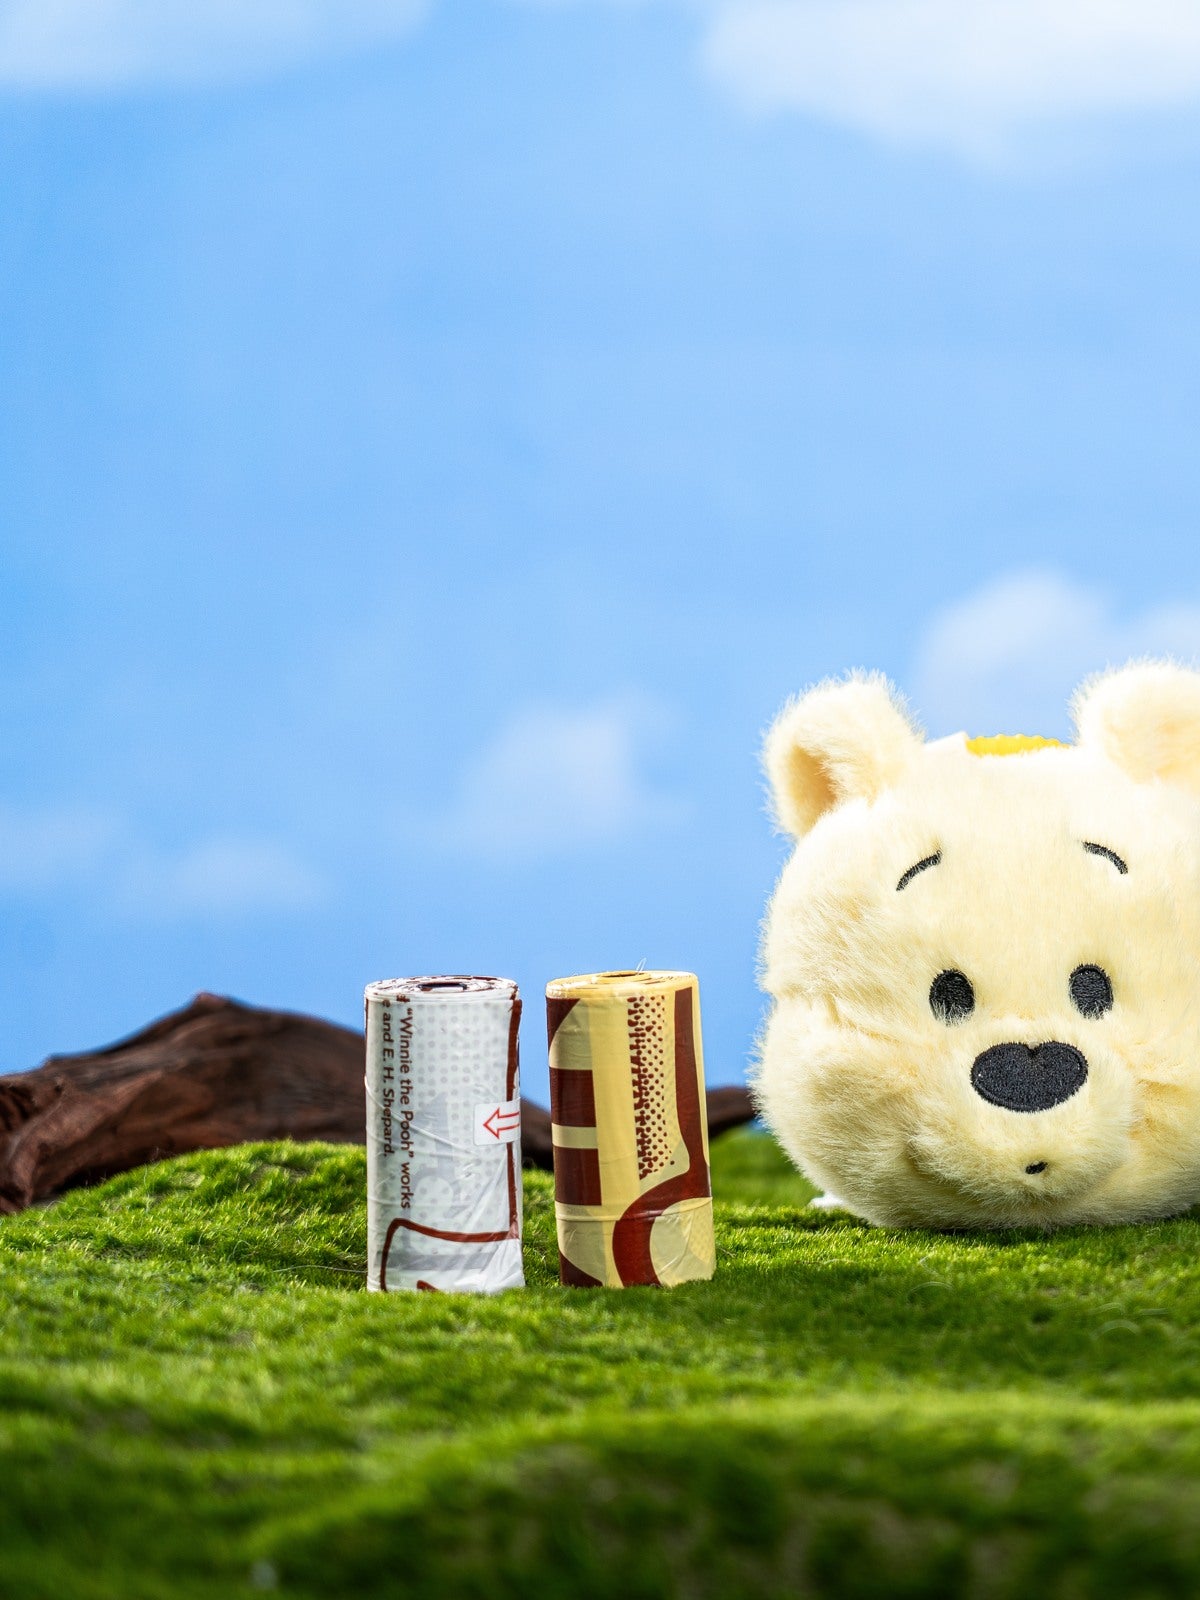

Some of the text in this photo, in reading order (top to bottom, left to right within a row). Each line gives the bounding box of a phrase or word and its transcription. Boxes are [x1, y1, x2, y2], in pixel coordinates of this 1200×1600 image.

[383, 1012, 394, 1043] and
[400, 1007, 413, 1074] “Winnie
[383, 1048, 394, 1062] E.
[383, 1066, 394, 1083] H.
[400, 1079, 413, 1105] the
[381, 1088, 395, 1158] Shepard.
[400, 1110, 414, 1158] Pooh”
[400, 1162, 414, 1209] works
